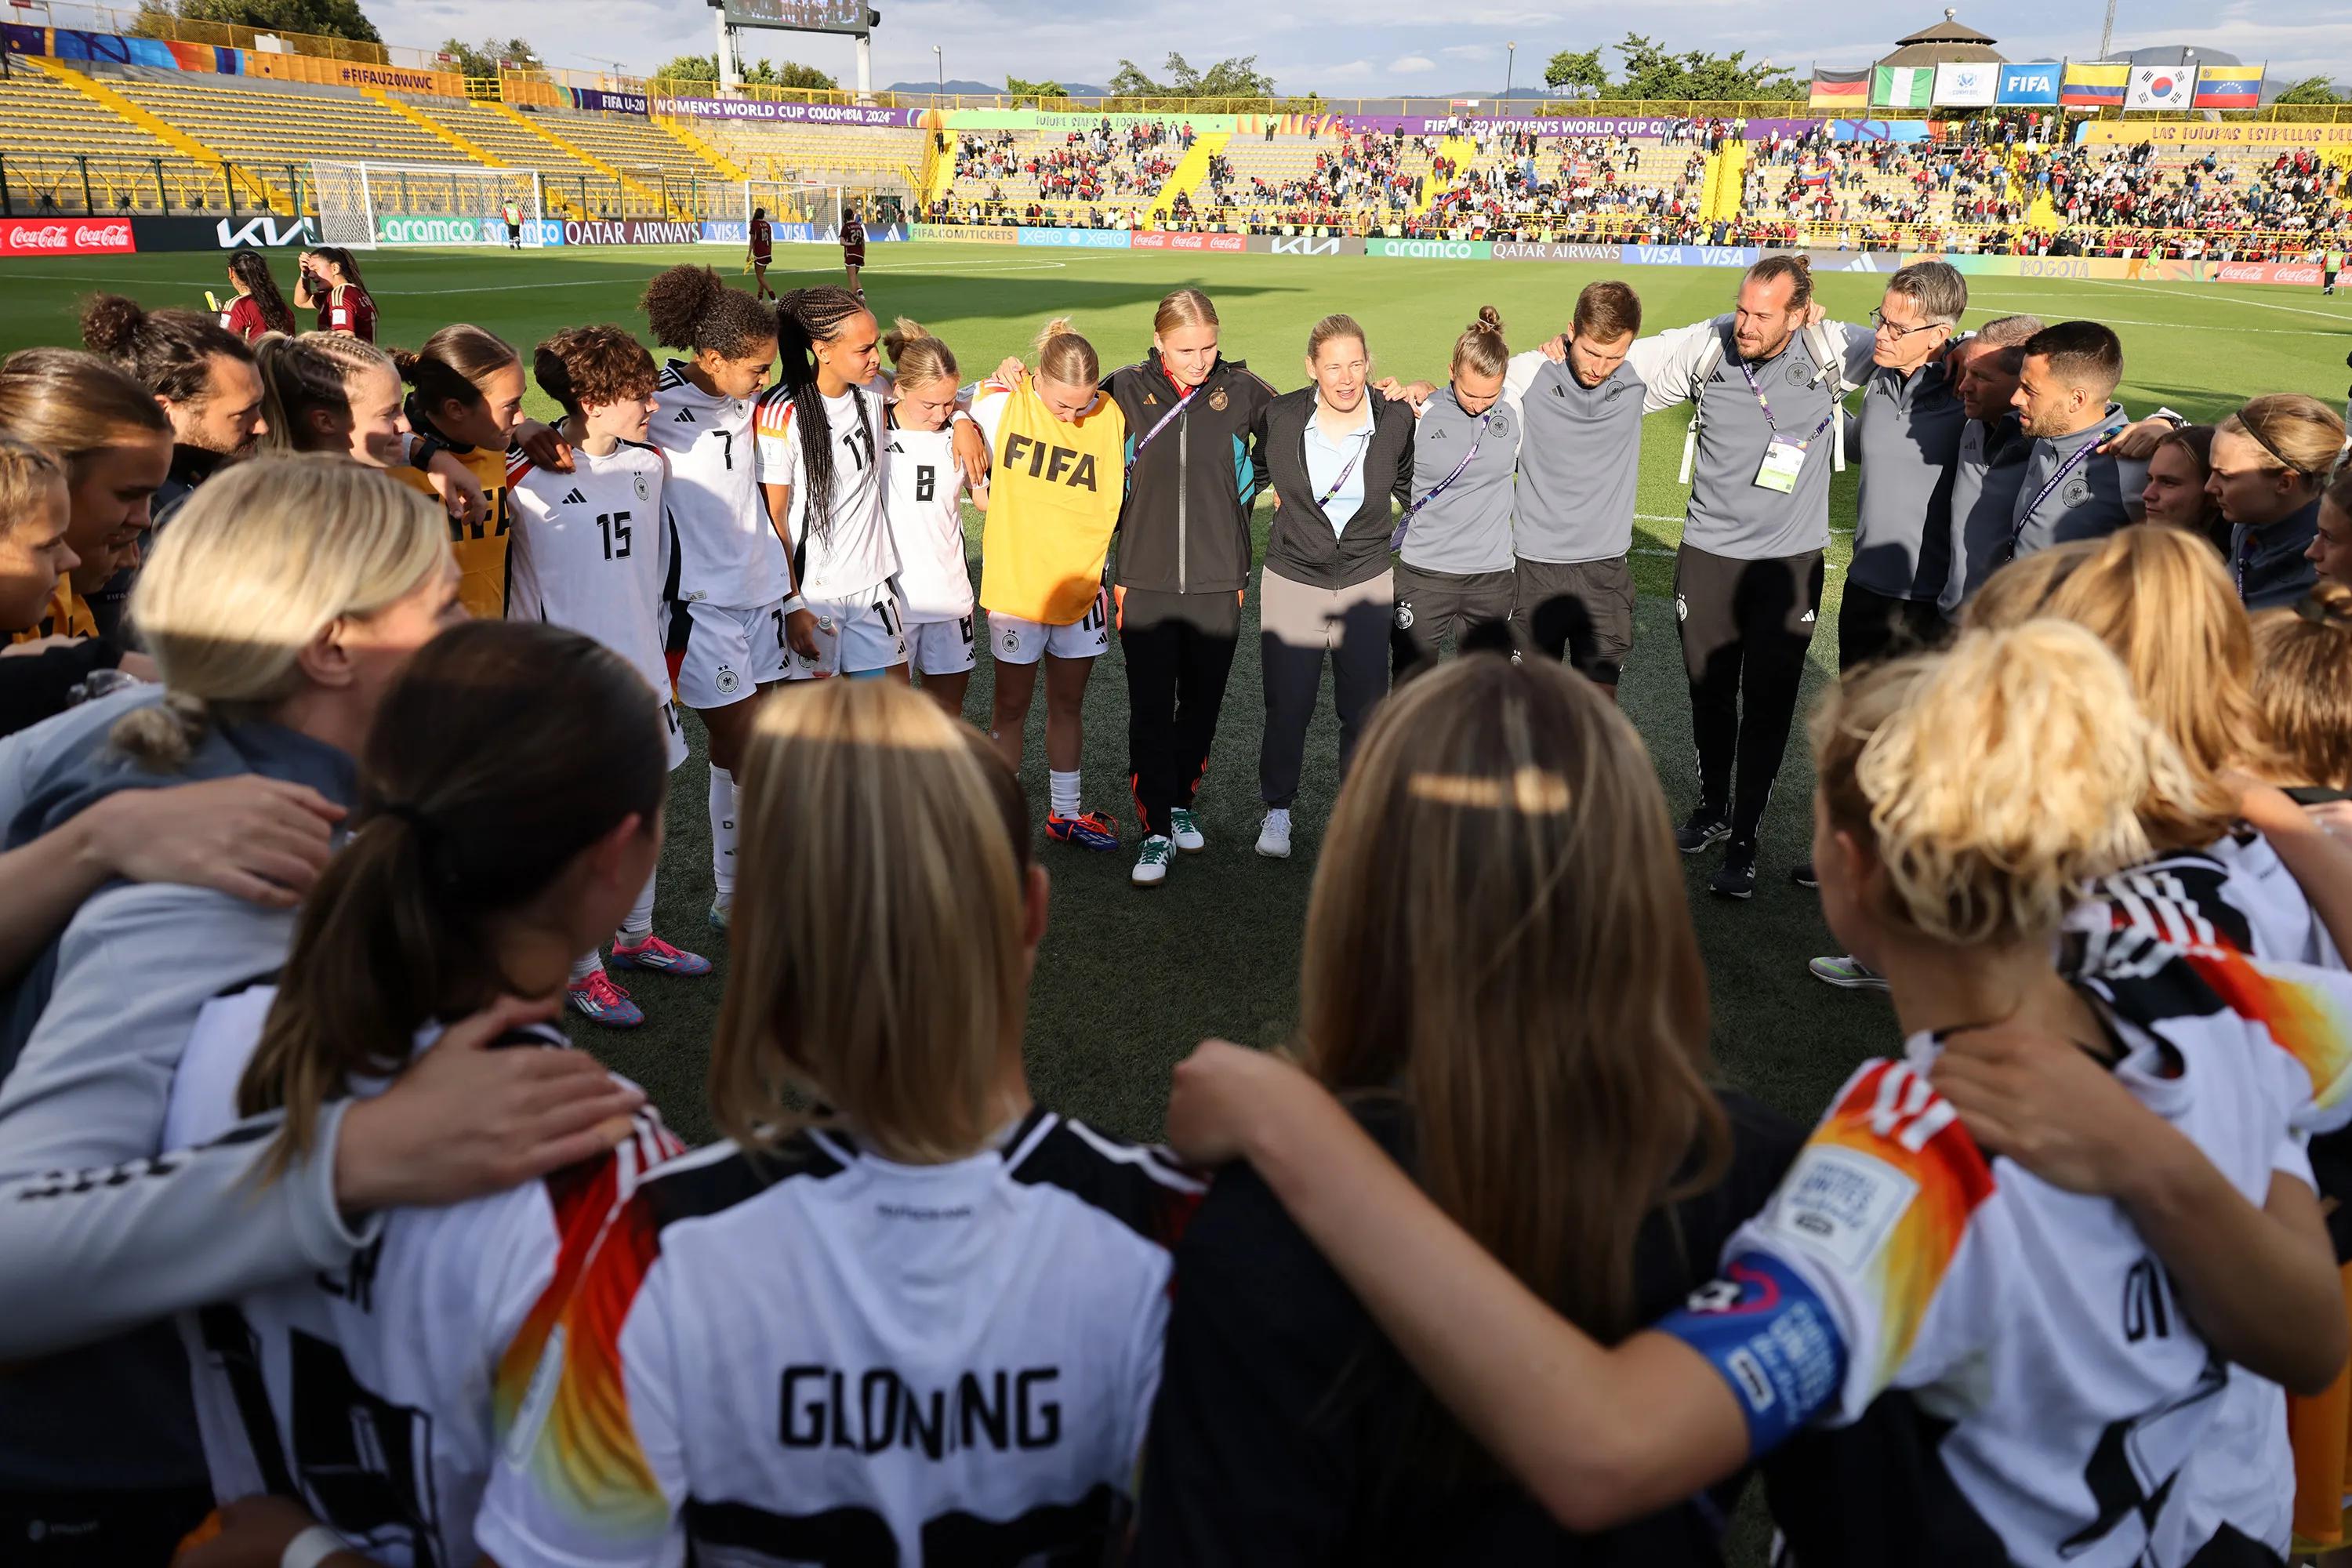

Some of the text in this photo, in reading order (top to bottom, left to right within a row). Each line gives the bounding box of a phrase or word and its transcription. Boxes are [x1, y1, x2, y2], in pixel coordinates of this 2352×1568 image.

[342, 67, 434, 90] #FIFAU20WWC
[2007, 76, 2051, 92] FIFA
[602, 95, 623, 110] FIFA
[625, 98, 645, 111] U-20
[653, 99, 721, 114] WOMEN'S
[723, 103, 775, 117] WORLD
[778, 105, 804, 118] CUP
[808, 107, 863, 122] COLOMBIA
[1036, 116, 1098, 127] FUTURE STARS
[1562, 121, 1614, 134] WORLD
[1617, 121, 1647, 134] CUP
[2152, 126, 2176, 140] LAS
[2183, 127, 2241, 140] FUTURAS
[2248, 127, 2323, 142] ESTRELLAS
[9, 225, 129, 249] Coca-Cola Coca-Cola
[385, 220, 474, 241] aramco
[565, 222, 700, 245] QATAR AIRWAYS
[710, 224, 807, 241] VISA VISA
[913, 227, 1013, 241] FIFA.COM/TICKETS
[1023, 230, 1126, 245] xero xero
[1134, 234, 1243, 249] Coca-Cola Coca-Cola Coca-Cola
[1271, 237, 1340, 256] KIA
[1385, 241, 1472, 259] aramco
[1493, 243, 1621, 260] QATAR AIRWAYS
[1635, 246, 1744, 266] VISA VISA
[2020, 259, 2089, 278] BOGOTÁ
[2220, 266, 2266, 280] Coca-Cola
[2274, 267, 2322, 282] Coca-Cola
[712, 430, 733, 471] 7
[1004, 432, 1098, 492] FIFA
[916, 465, 936, 503] 8
[2029, 491, 2045, 510] WOMEN'S
[2044, 477, 2059, 492] WORLD
[2057, 468, 2067, 478] CUP
[596, 510, 632, 561] 15
[872, 597, 902, 637] 11
[1083, 592, 1106, 632] 10
[959, 615, 974, 645] 8
[778, 1363, 1062, 1461] GLONNG
